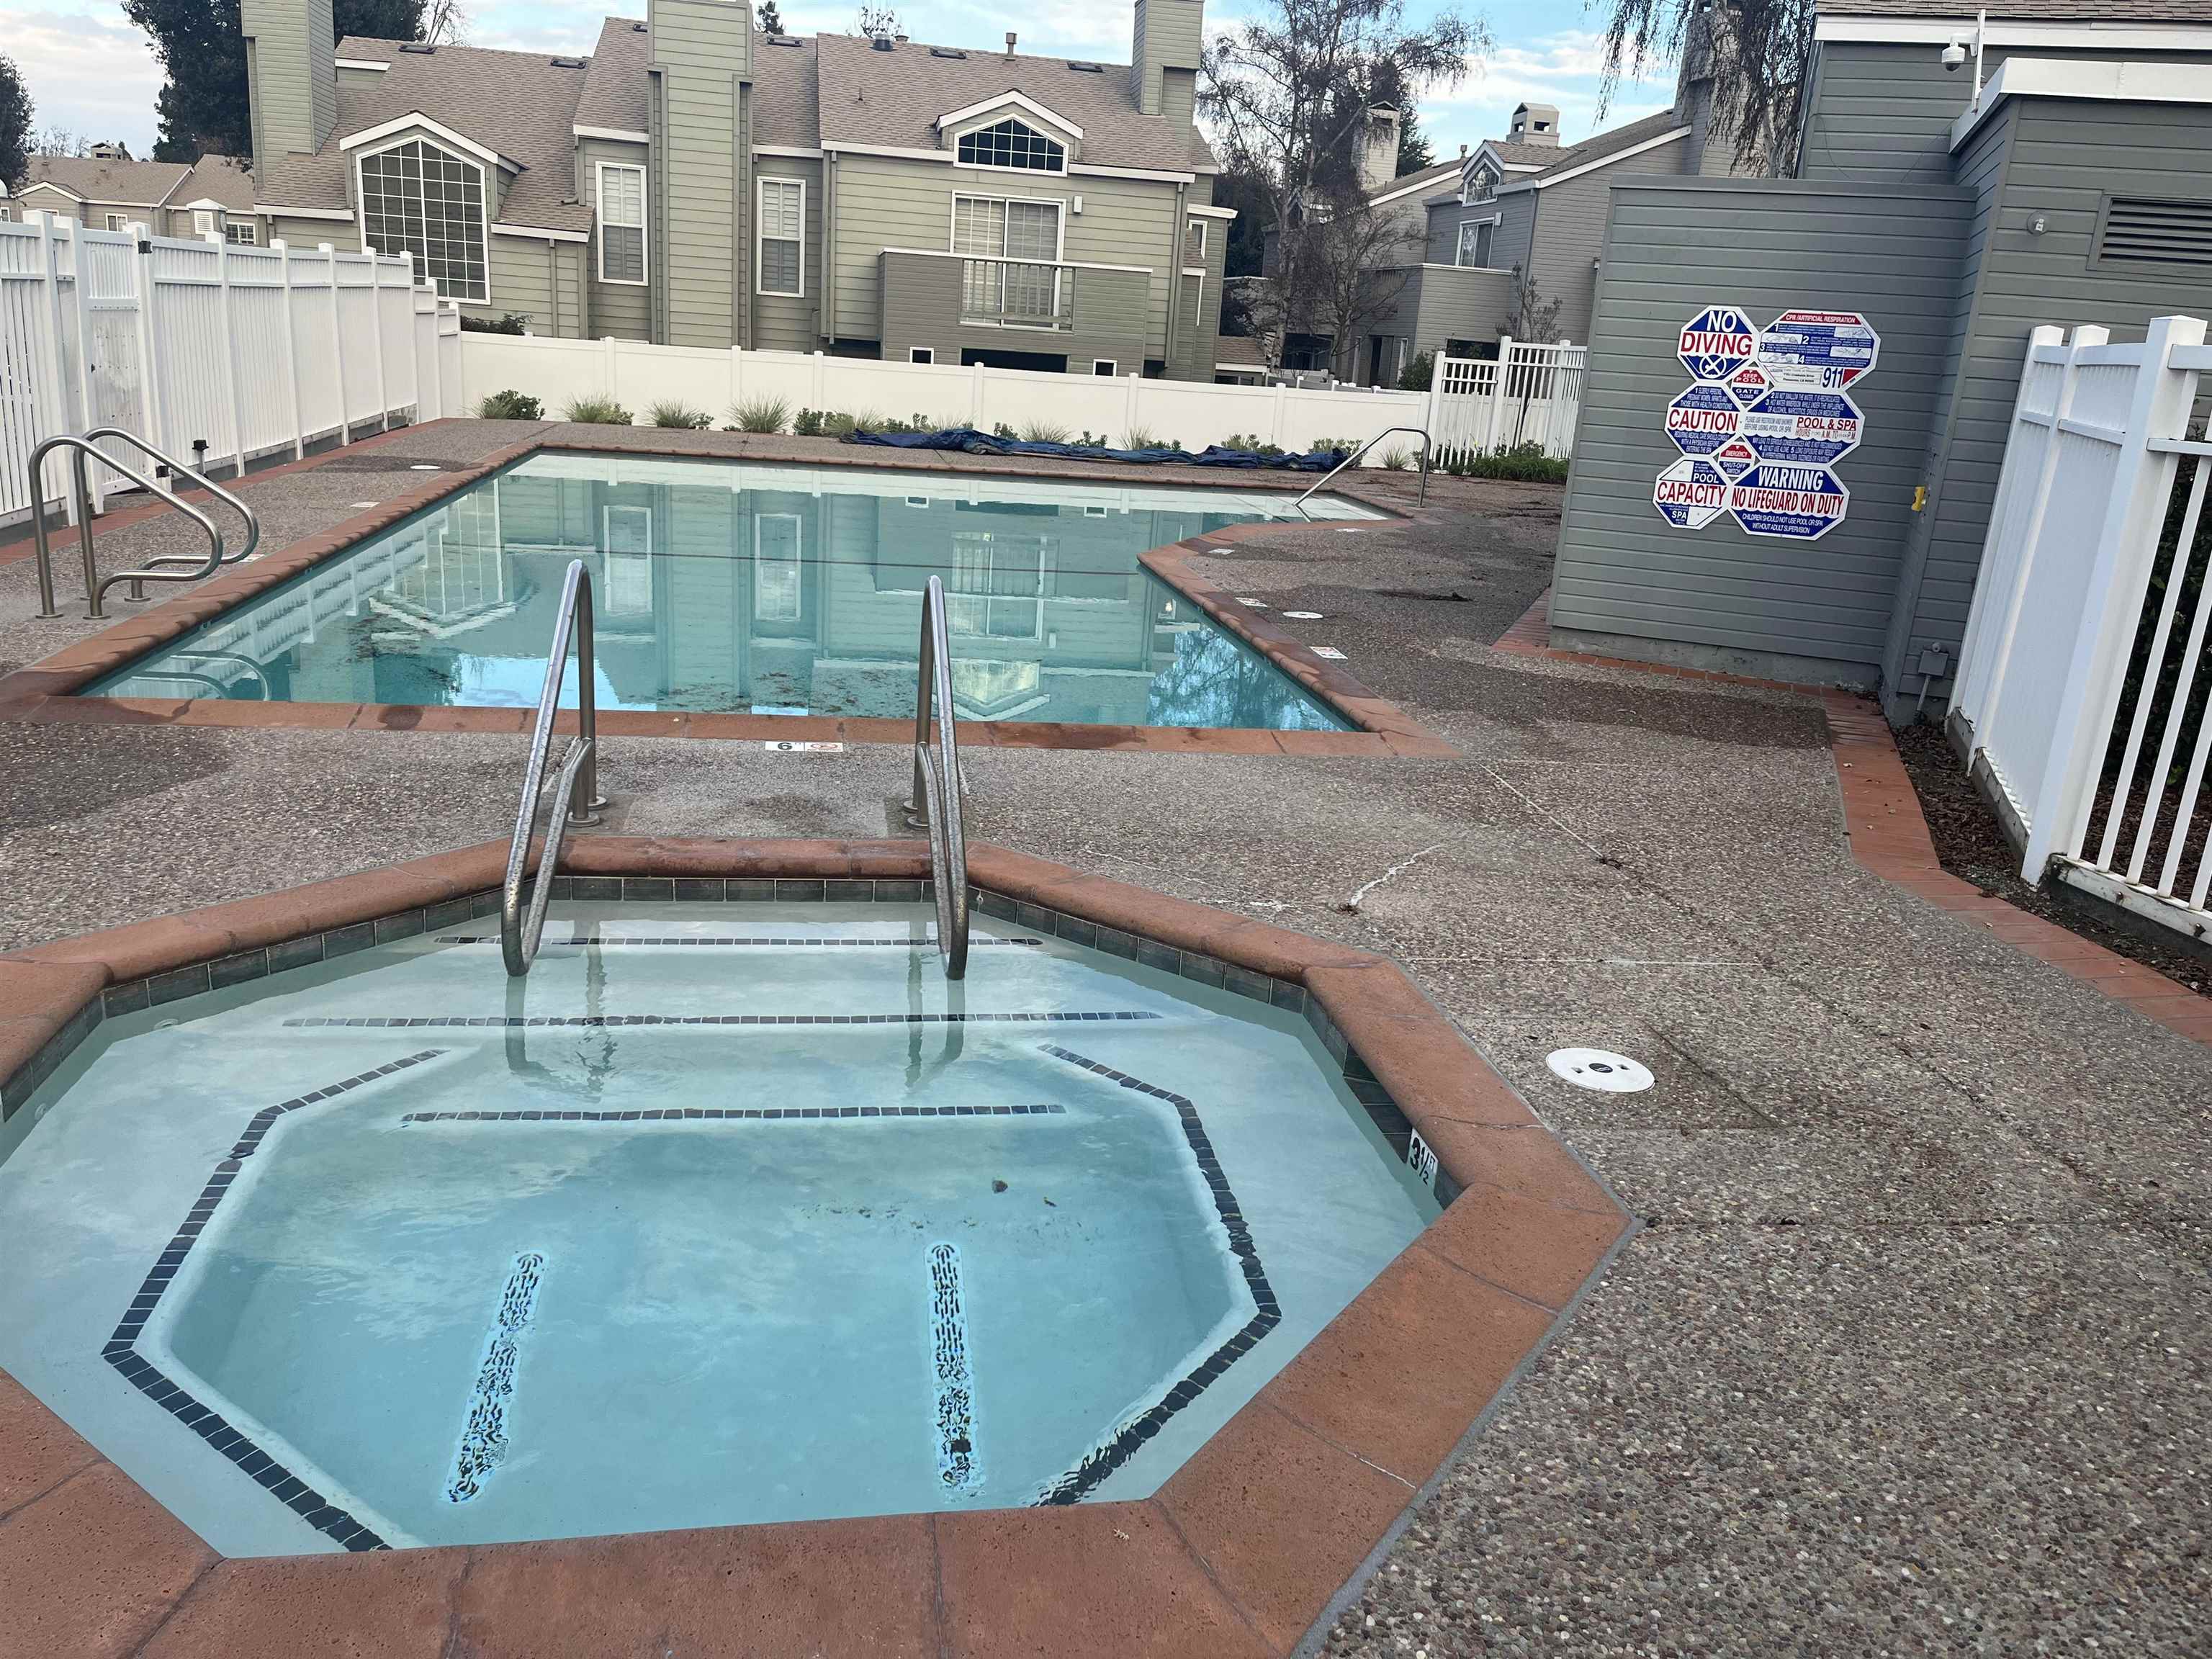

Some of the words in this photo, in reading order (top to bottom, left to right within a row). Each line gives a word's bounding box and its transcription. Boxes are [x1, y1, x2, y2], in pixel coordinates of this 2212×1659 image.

[1707, 310, 1737, 333] NO
[1681, 332, 1753, 356] DIVING
[1760, 343, 1766, 351] 3
[1802, 336, 1809, 345] 2
[1799, 355, 1804, 364] 4
[1822, 367, 1843, 389] 911
[1669, 409, 1738, 431] CAUTION
[1797, 417, 1825, 428] POOL
[1828, 419, 1834, 429] &
[1837, 420, 1856, 431] SPA
[1795, 428, 1810, 437] HOURS
[1693, 473, 1719, 483] POOL
[1758, 467, 1824, 491] WARNING
[1658, 482, 1727, 505] CAPACITY
[1731, 488, 1745, 507] NO
[1748, 489, 1799, 511] LIFEGUARD
[1801, 493, 1816, 513] ON
[1817, 495, 1844, 516] DUTY
[1672, 511, 1686, 519] SPA
[778, 742, 792, 750] 6
